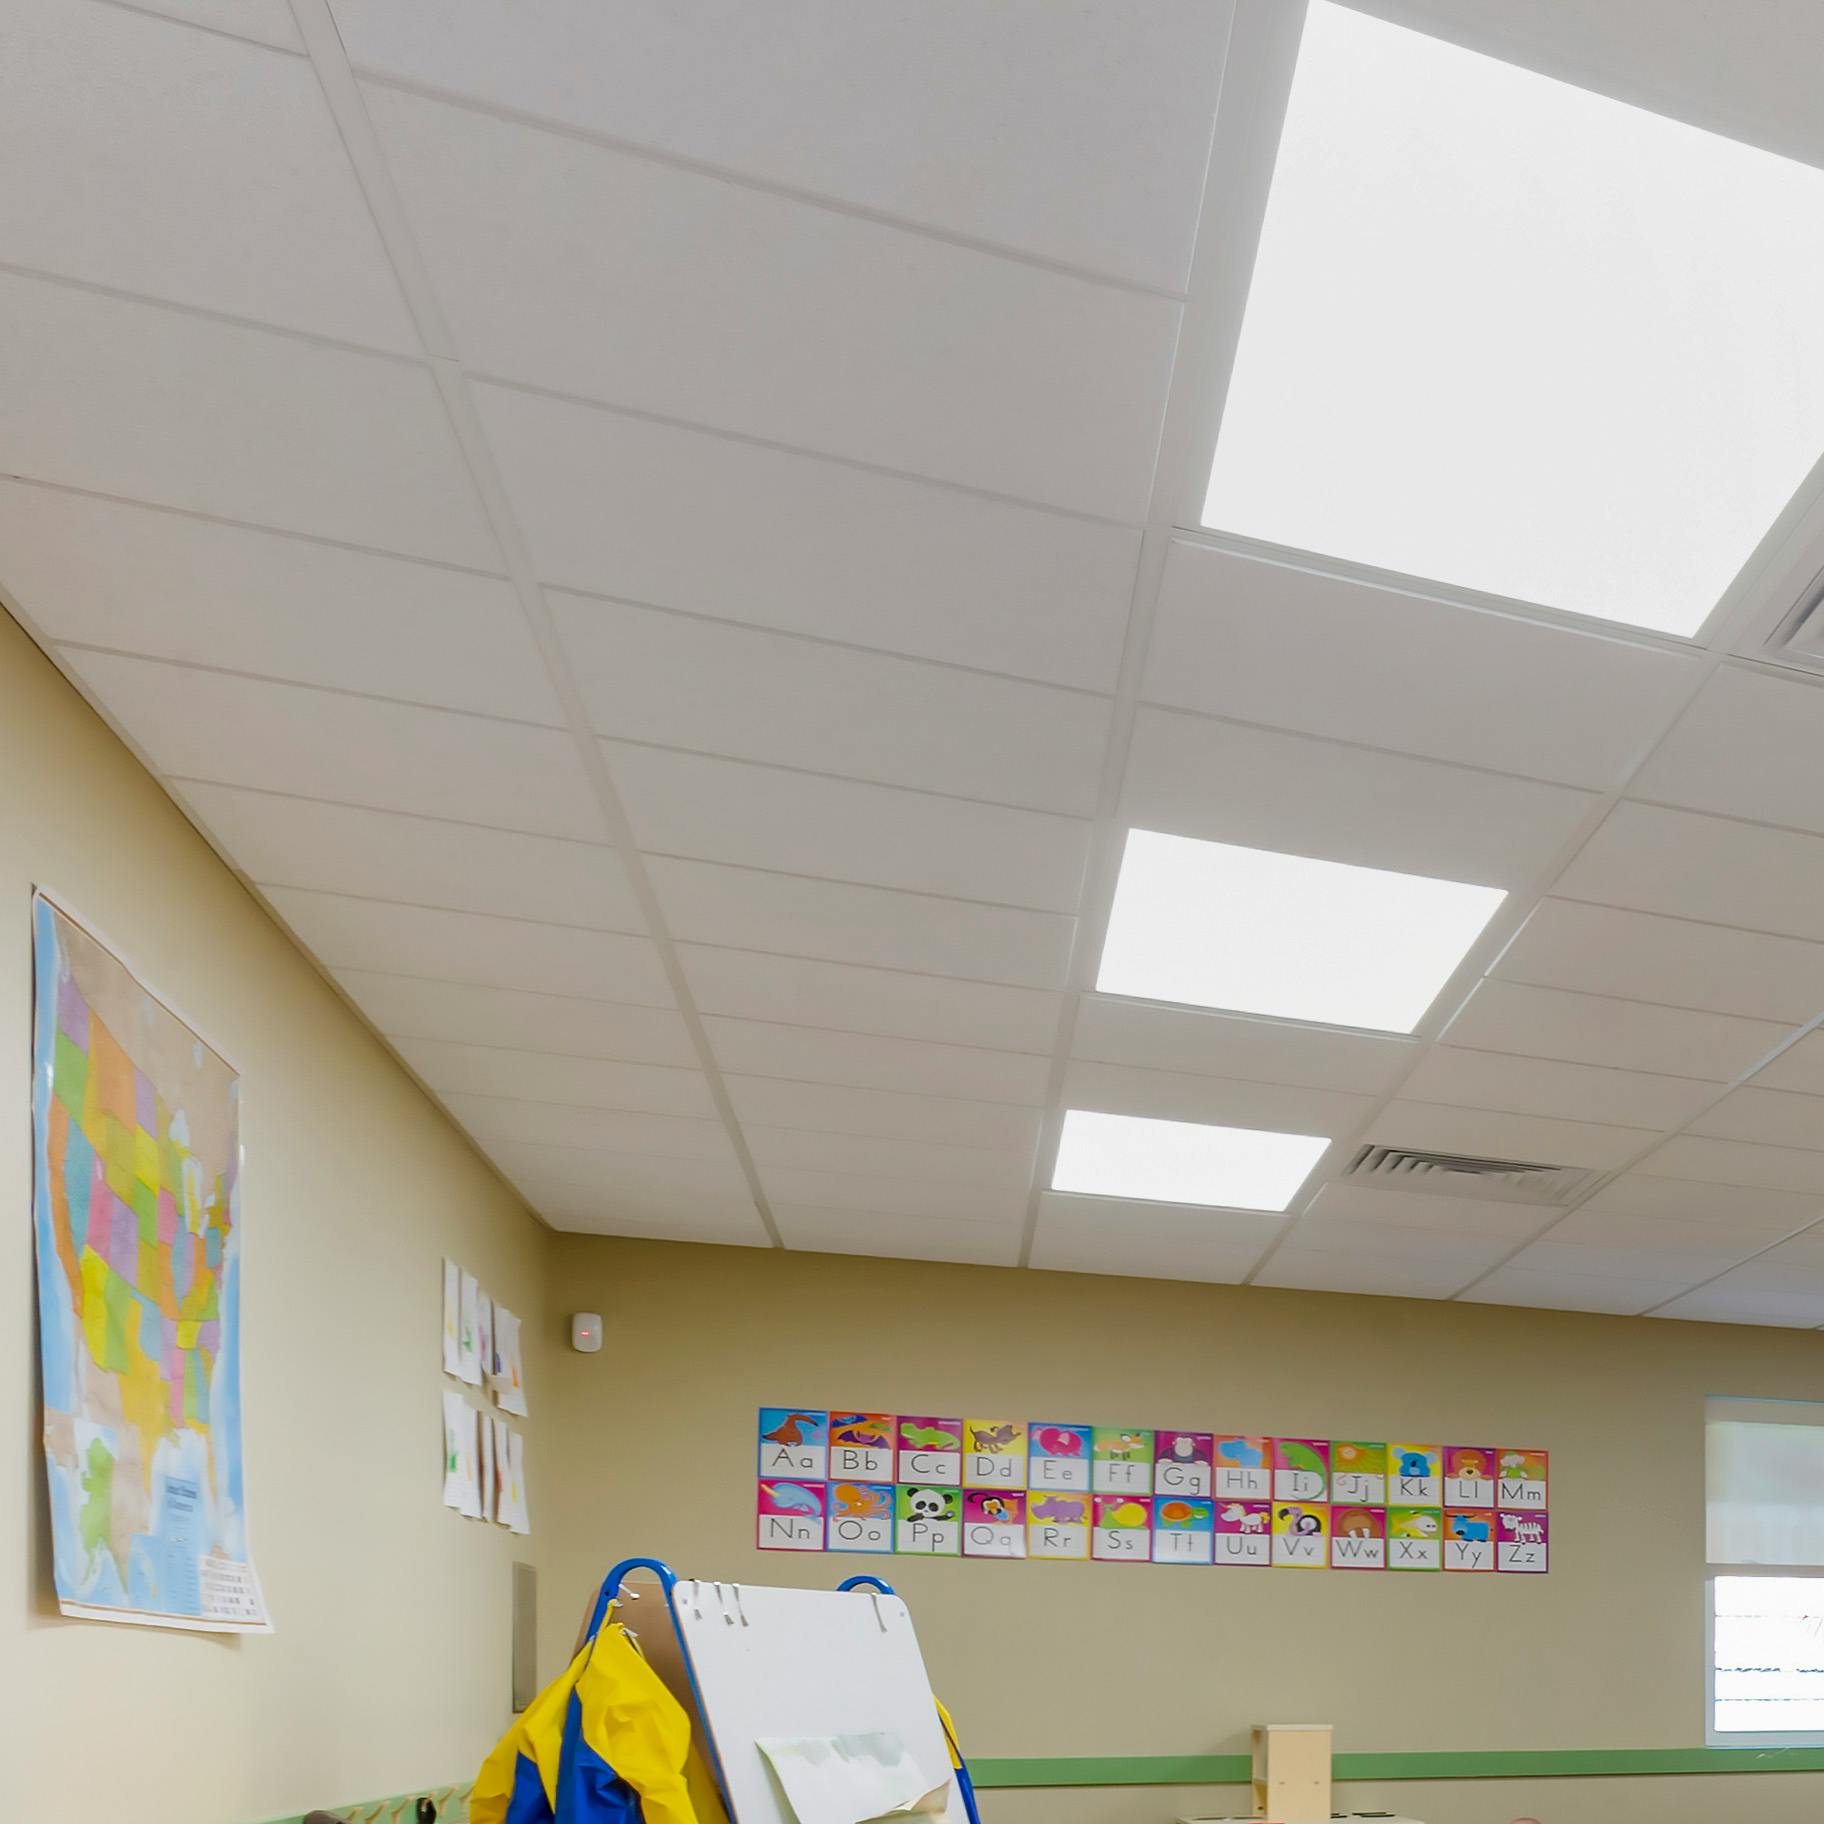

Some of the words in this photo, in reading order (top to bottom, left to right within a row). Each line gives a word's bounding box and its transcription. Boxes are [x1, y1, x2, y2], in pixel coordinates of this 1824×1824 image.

[771, 1447, 814, 1468] Aa
[843, 1449, 878, 1472] Bb
[910, 1453, 947, 1475] Cc
[976, 1456, 1013, 1478] Dd
[1042, 1459, 1074, 1481] Ee
[1108, 1462, 1136, 1484] Ff
[1163, 1466, 1202, 1495] Gg
[1225, 1469, 1258, 1490] Hh
[1347, 1474, 1369, 1502] Jj
[1400, 1477, 1429, 1497] Kk
[1458, 1479, 1478, 1499] Ll
[1501, 1482, 1542, 1501] Mm
[770, 1517, 811, 1540] Nn
[838, 1519, 882, 1541] Oo
[911, 1522, 945, 1553] Pp
[970, 1525, 1015, 1554] Qq
[1043, 1527, 1071, 1549] Rr
[1107, 1530, 1134, 1551] Ss
[1225, 1535, 1257, 1556] Uu
[1283, 1537, 1314, 1557] Vv
[1336, 1539, 1380, 1559] Ww
[1399, 1541, 1429, 1561] Xx
[1455, 1543, 1482, 1568] Yy
[1508, 1545, 1536, 1564] Zz
